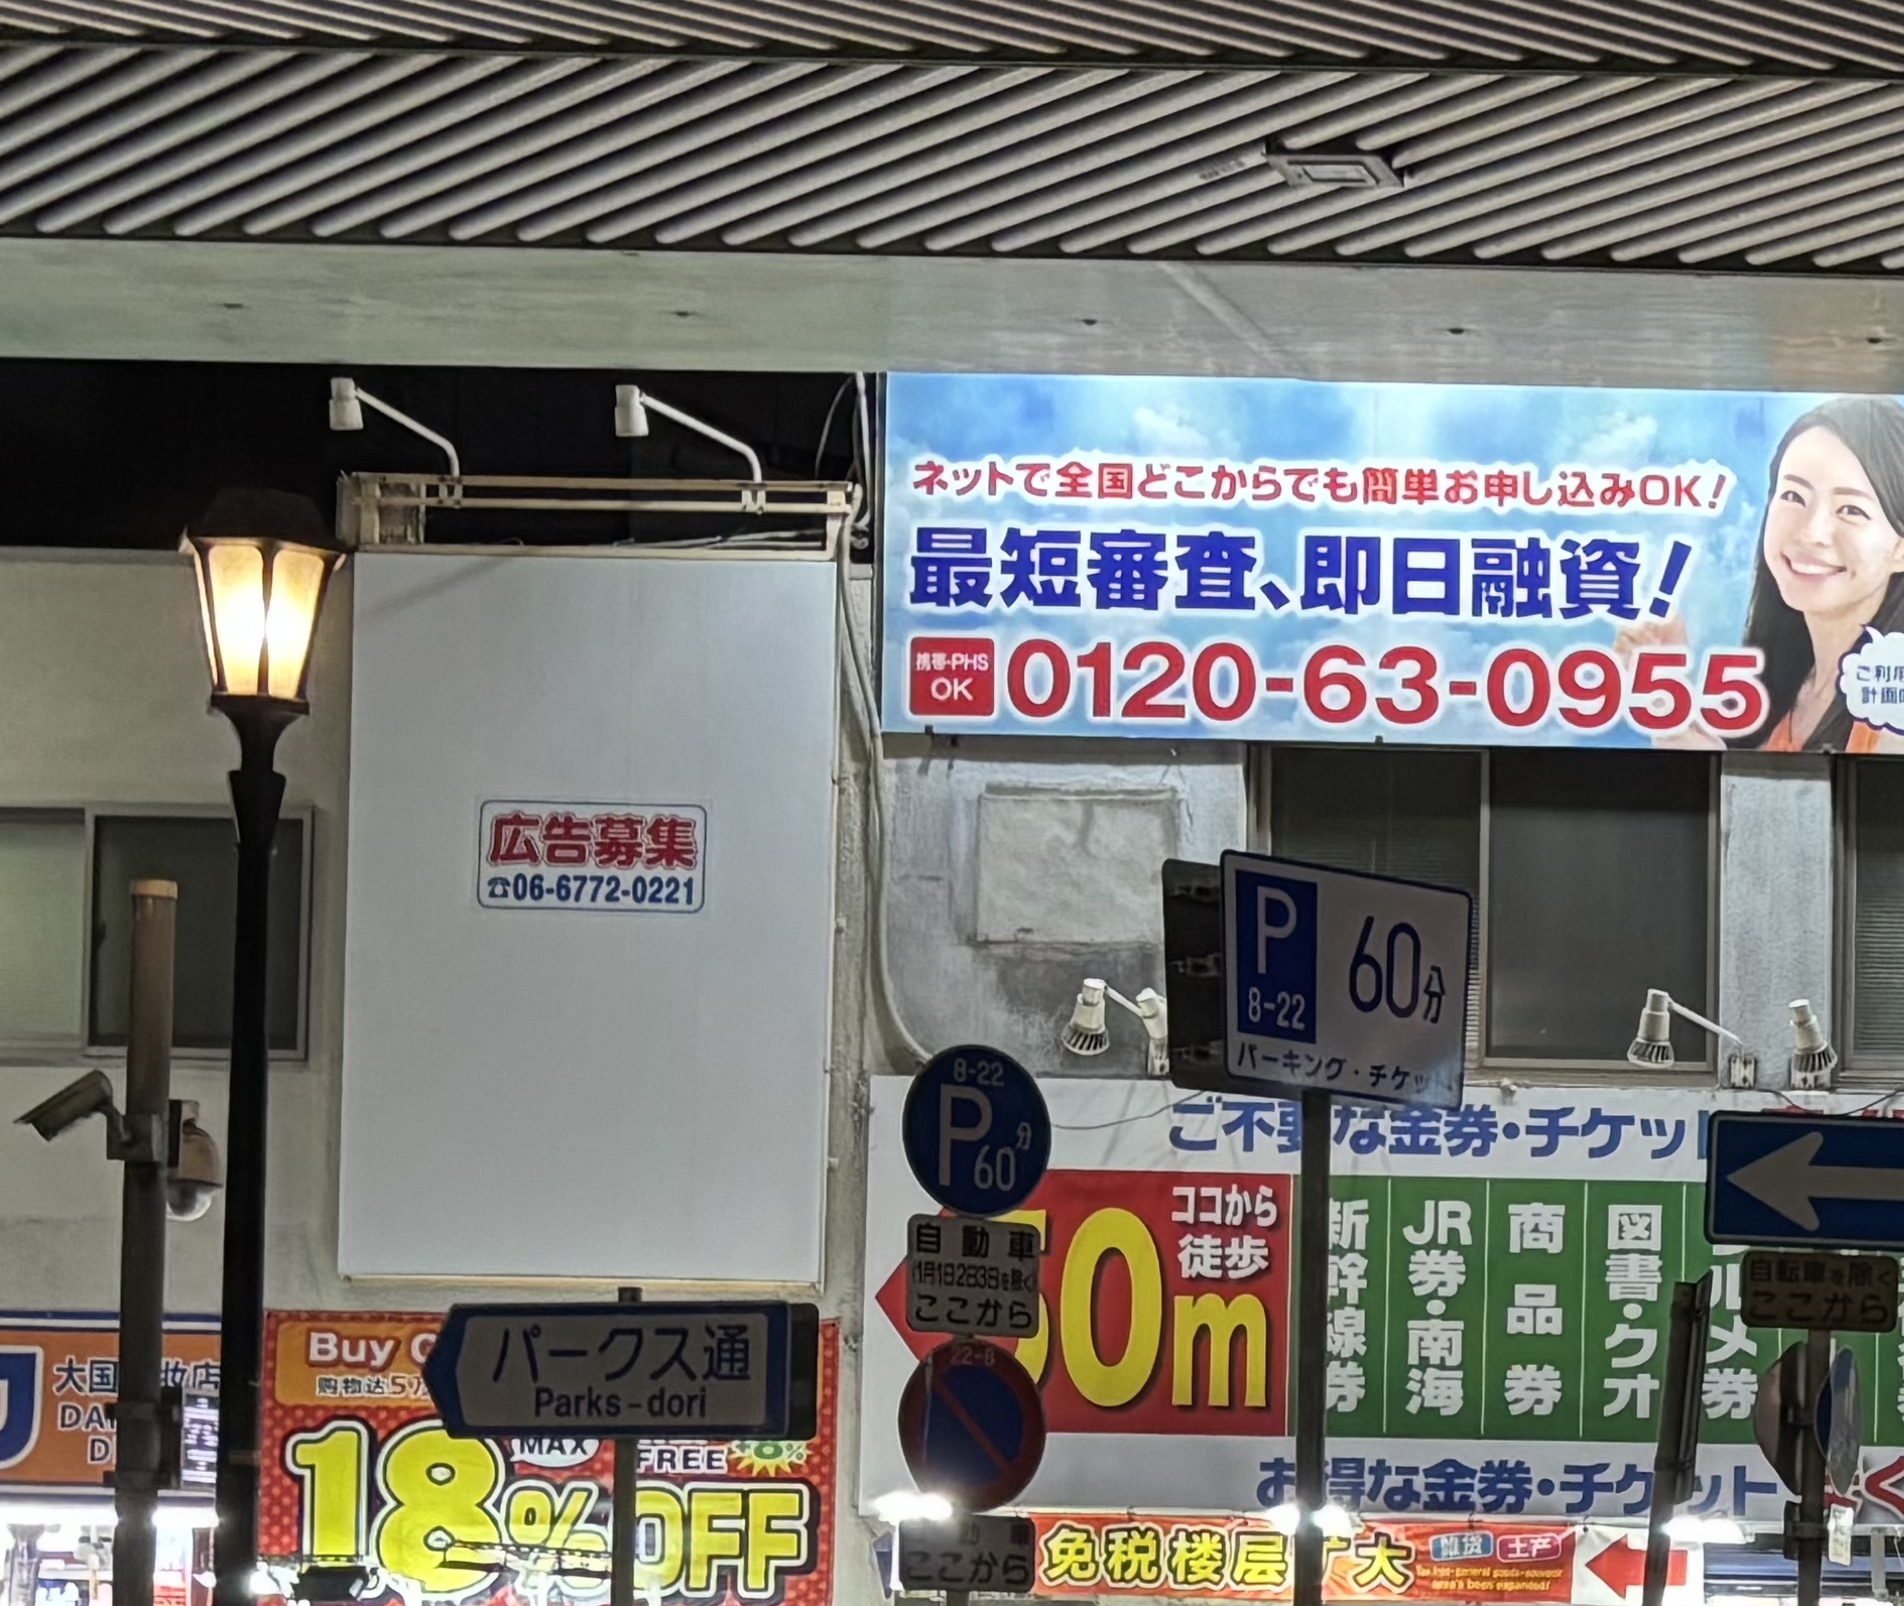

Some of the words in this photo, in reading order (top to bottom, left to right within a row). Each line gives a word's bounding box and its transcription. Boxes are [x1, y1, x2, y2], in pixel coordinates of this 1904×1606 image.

[911, 528, 1693, 619] 最短審査、即日融資!
[931, 677, 974, 703] OK
[1007, 638, 1767, 733] 0120-63-0955
[488, 812, 698, 869] 広告募集
[513, 873, 694, 905] 06-6772-0221
[1257, 886, 1297, 975] P
[1249, 987, 1305, 1031] 8-22
[954, 1059, 1004, 1086] 8-22
[937, 1085, 992, 1187] P
[1171, 1184, 1278, 1227] ココから
[915, 1224, 1038, 1262] 自動車
[1178, 1236, 1269, 1279] 徒歩
[915, 1296, 1034, 1330] ここから
[1505, 1203, 1563, 1416] 商品券
[1751, 1291, 1888, 1324] ここから
[309, 1332, 394, 1367] Buy
[1702, 1245, 1758, 1419] ルメ券
[493, 1326, 751, 1382] パークス通
[635, 1446, 728, 1471] FREE
[908, 1551, 1028, 1585] ここから
